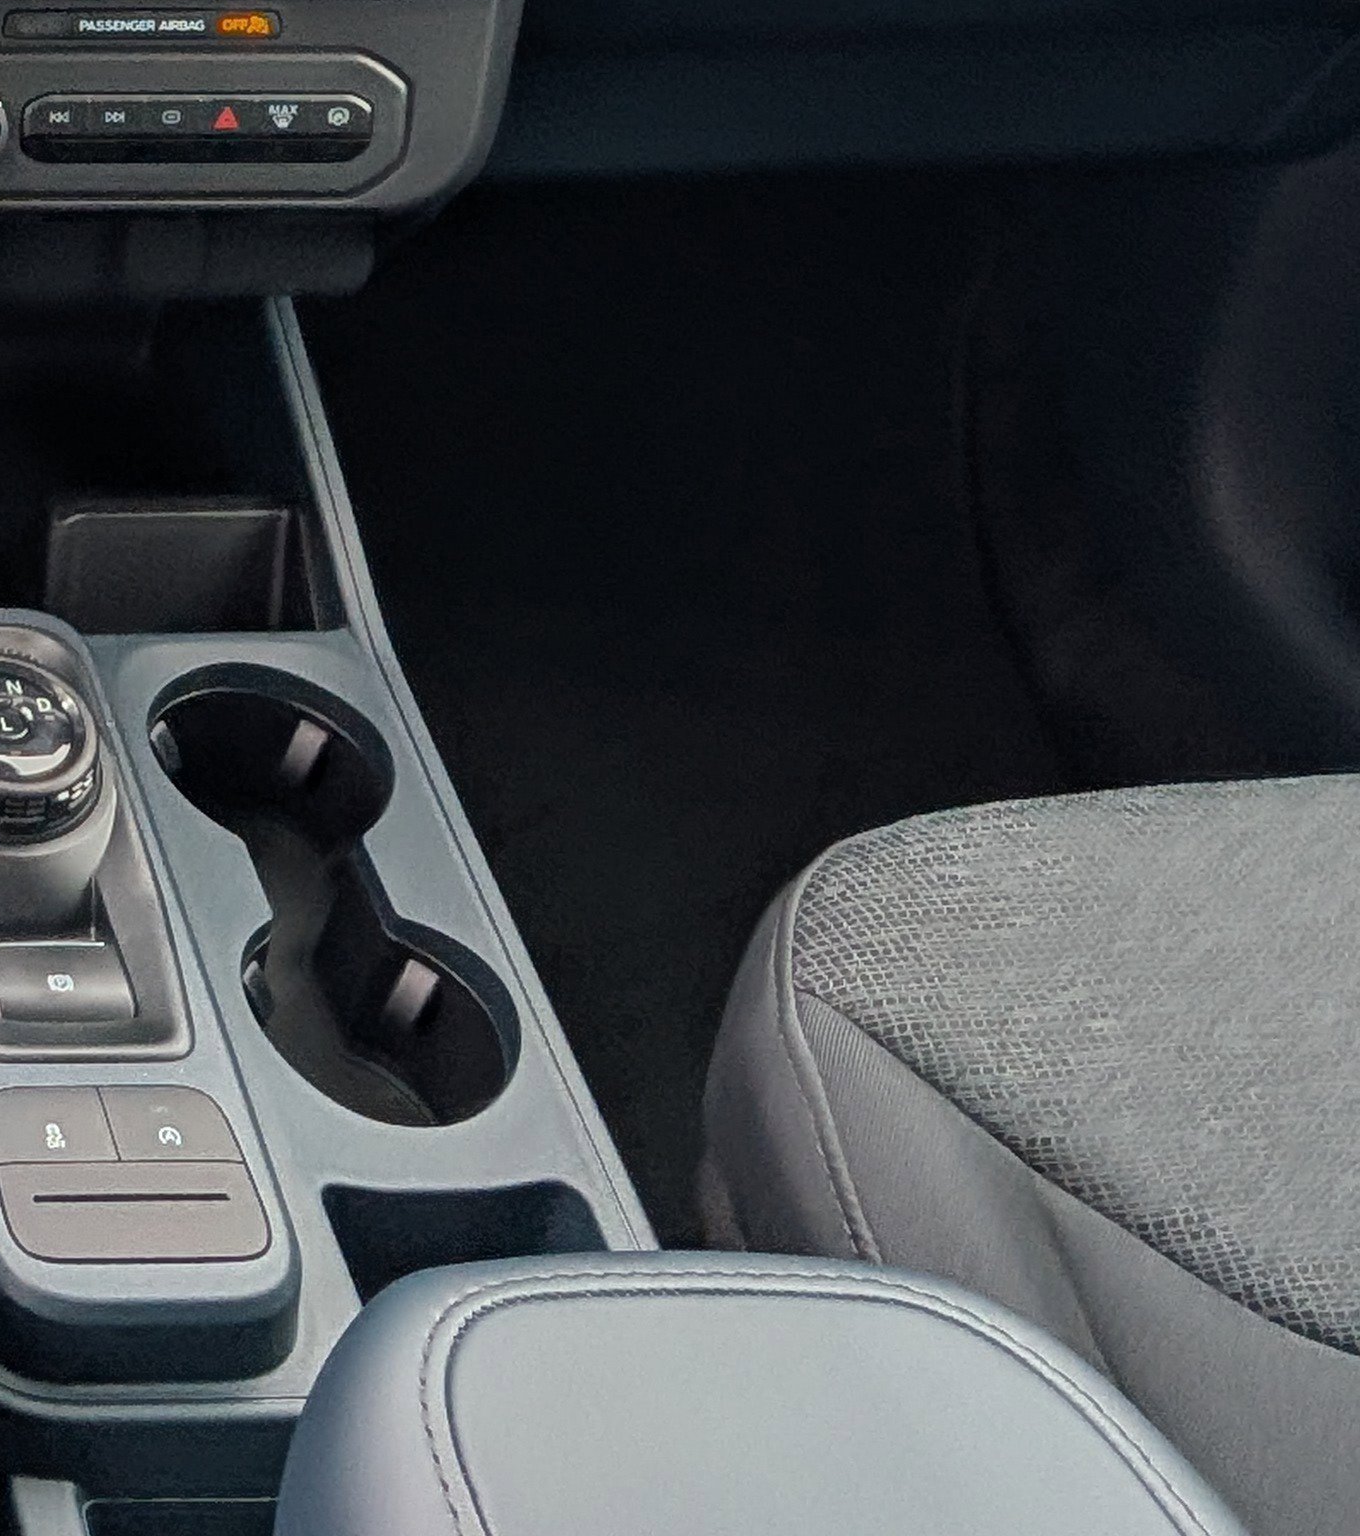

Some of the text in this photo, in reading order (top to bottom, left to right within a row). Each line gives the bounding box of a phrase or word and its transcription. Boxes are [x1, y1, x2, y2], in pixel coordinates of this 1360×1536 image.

[79, 19, 156, 32] PASSENGER
[158, 19, 206, 32] AIRBAG
[268, 104, 299, 116] MAX
[5, 679, 23, 696] N
[35, 697, 52, 713] D
[0, 716, 14, 732] L
